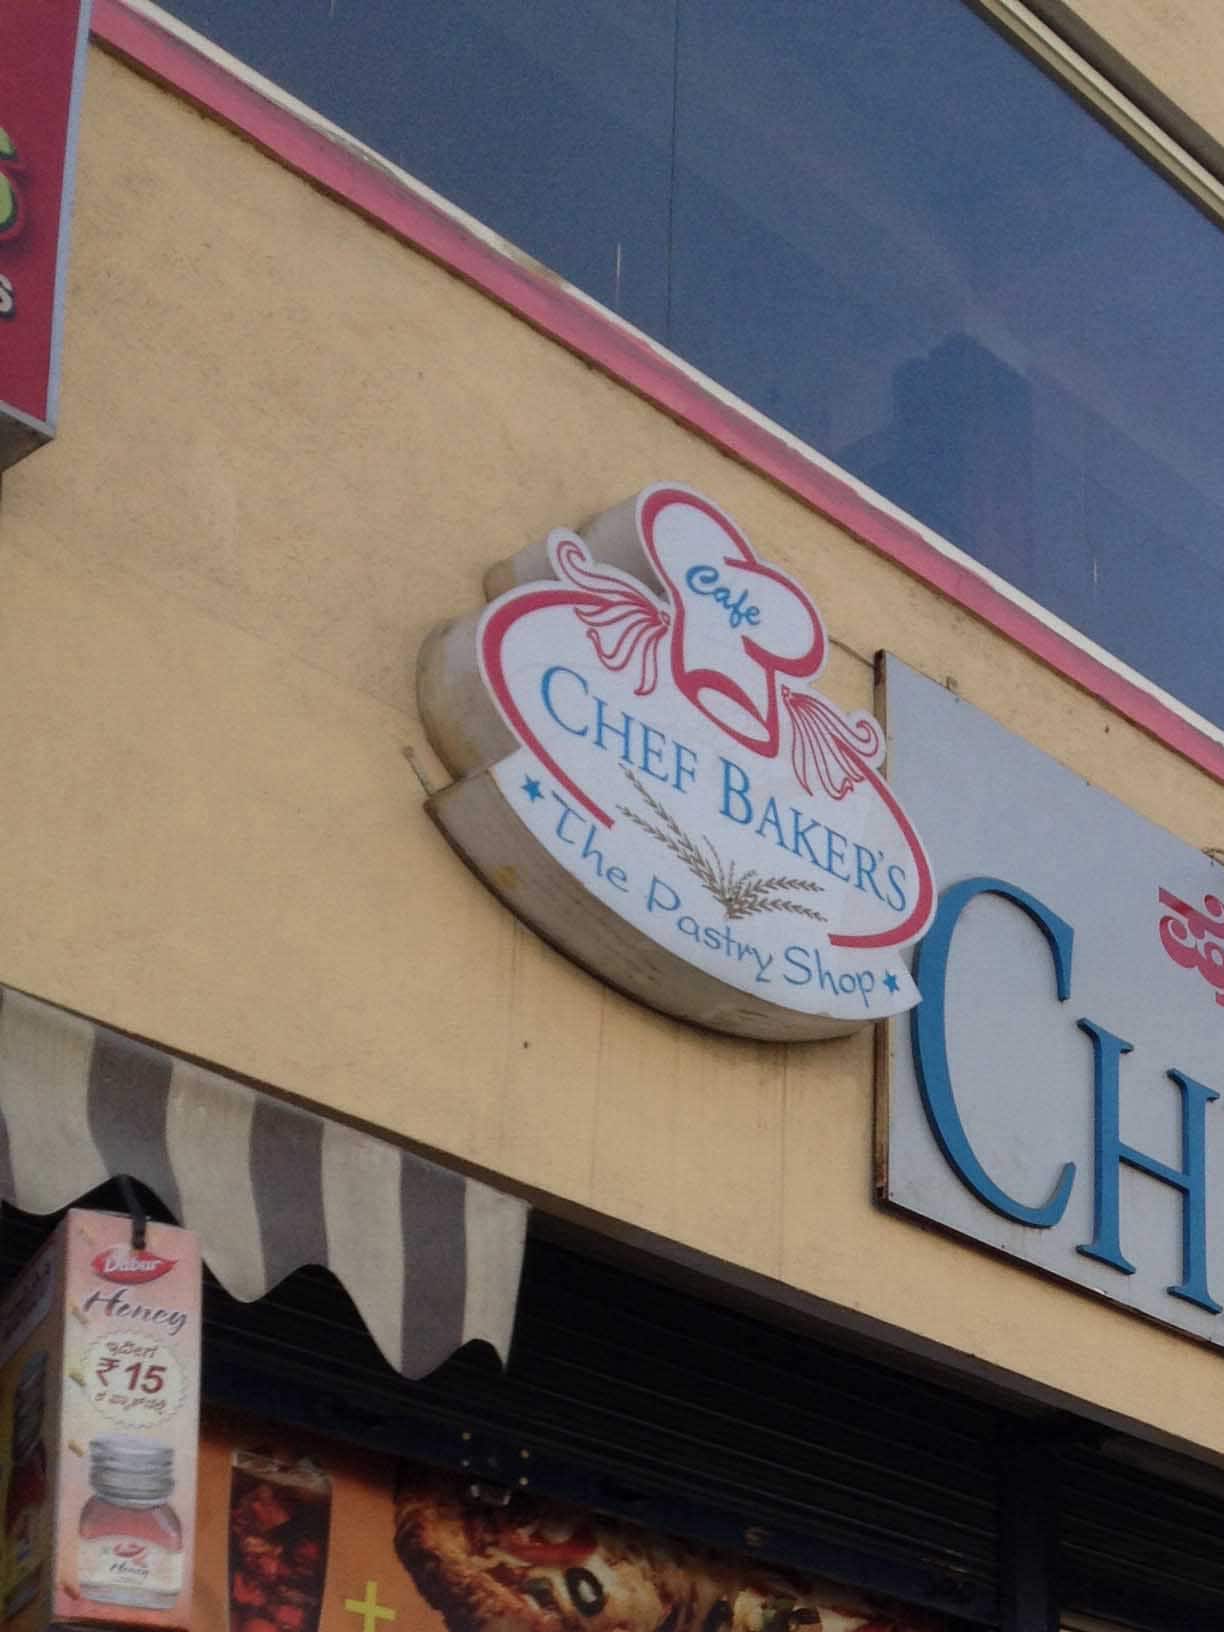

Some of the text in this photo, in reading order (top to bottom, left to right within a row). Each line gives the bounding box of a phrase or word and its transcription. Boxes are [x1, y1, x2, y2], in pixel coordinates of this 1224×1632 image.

[686, 565, 760, 629] Cafe
[541, 665, 907, 912] CHEF BAKER'S
[552, 790, 875, 1007] The Pastry Shop
[125, 1361, 168, 1393] 15
